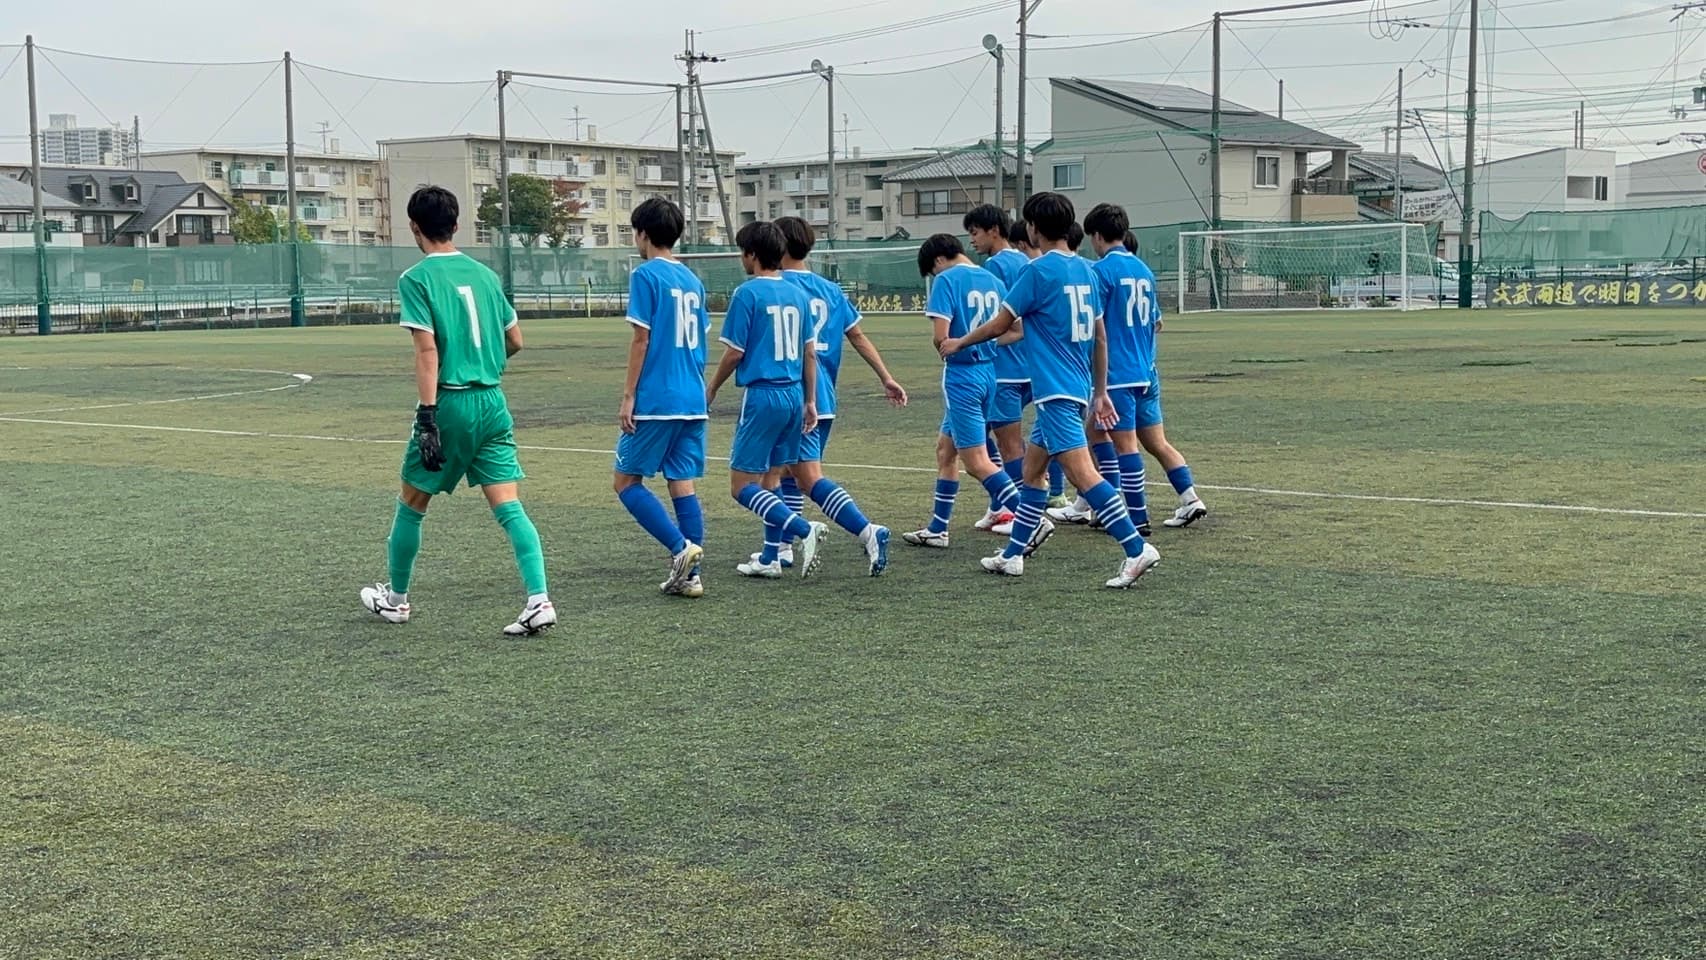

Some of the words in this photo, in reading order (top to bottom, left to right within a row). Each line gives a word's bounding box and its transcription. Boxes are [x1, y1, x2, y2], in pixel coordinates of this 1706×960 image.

[457, 285, 481, 348] 1
[671, 288, 700, 350] 16
[767, 305, 800, 361] 10
[810, 298, 829, 351] 2
[1064, 285, 1094, 343] 15
